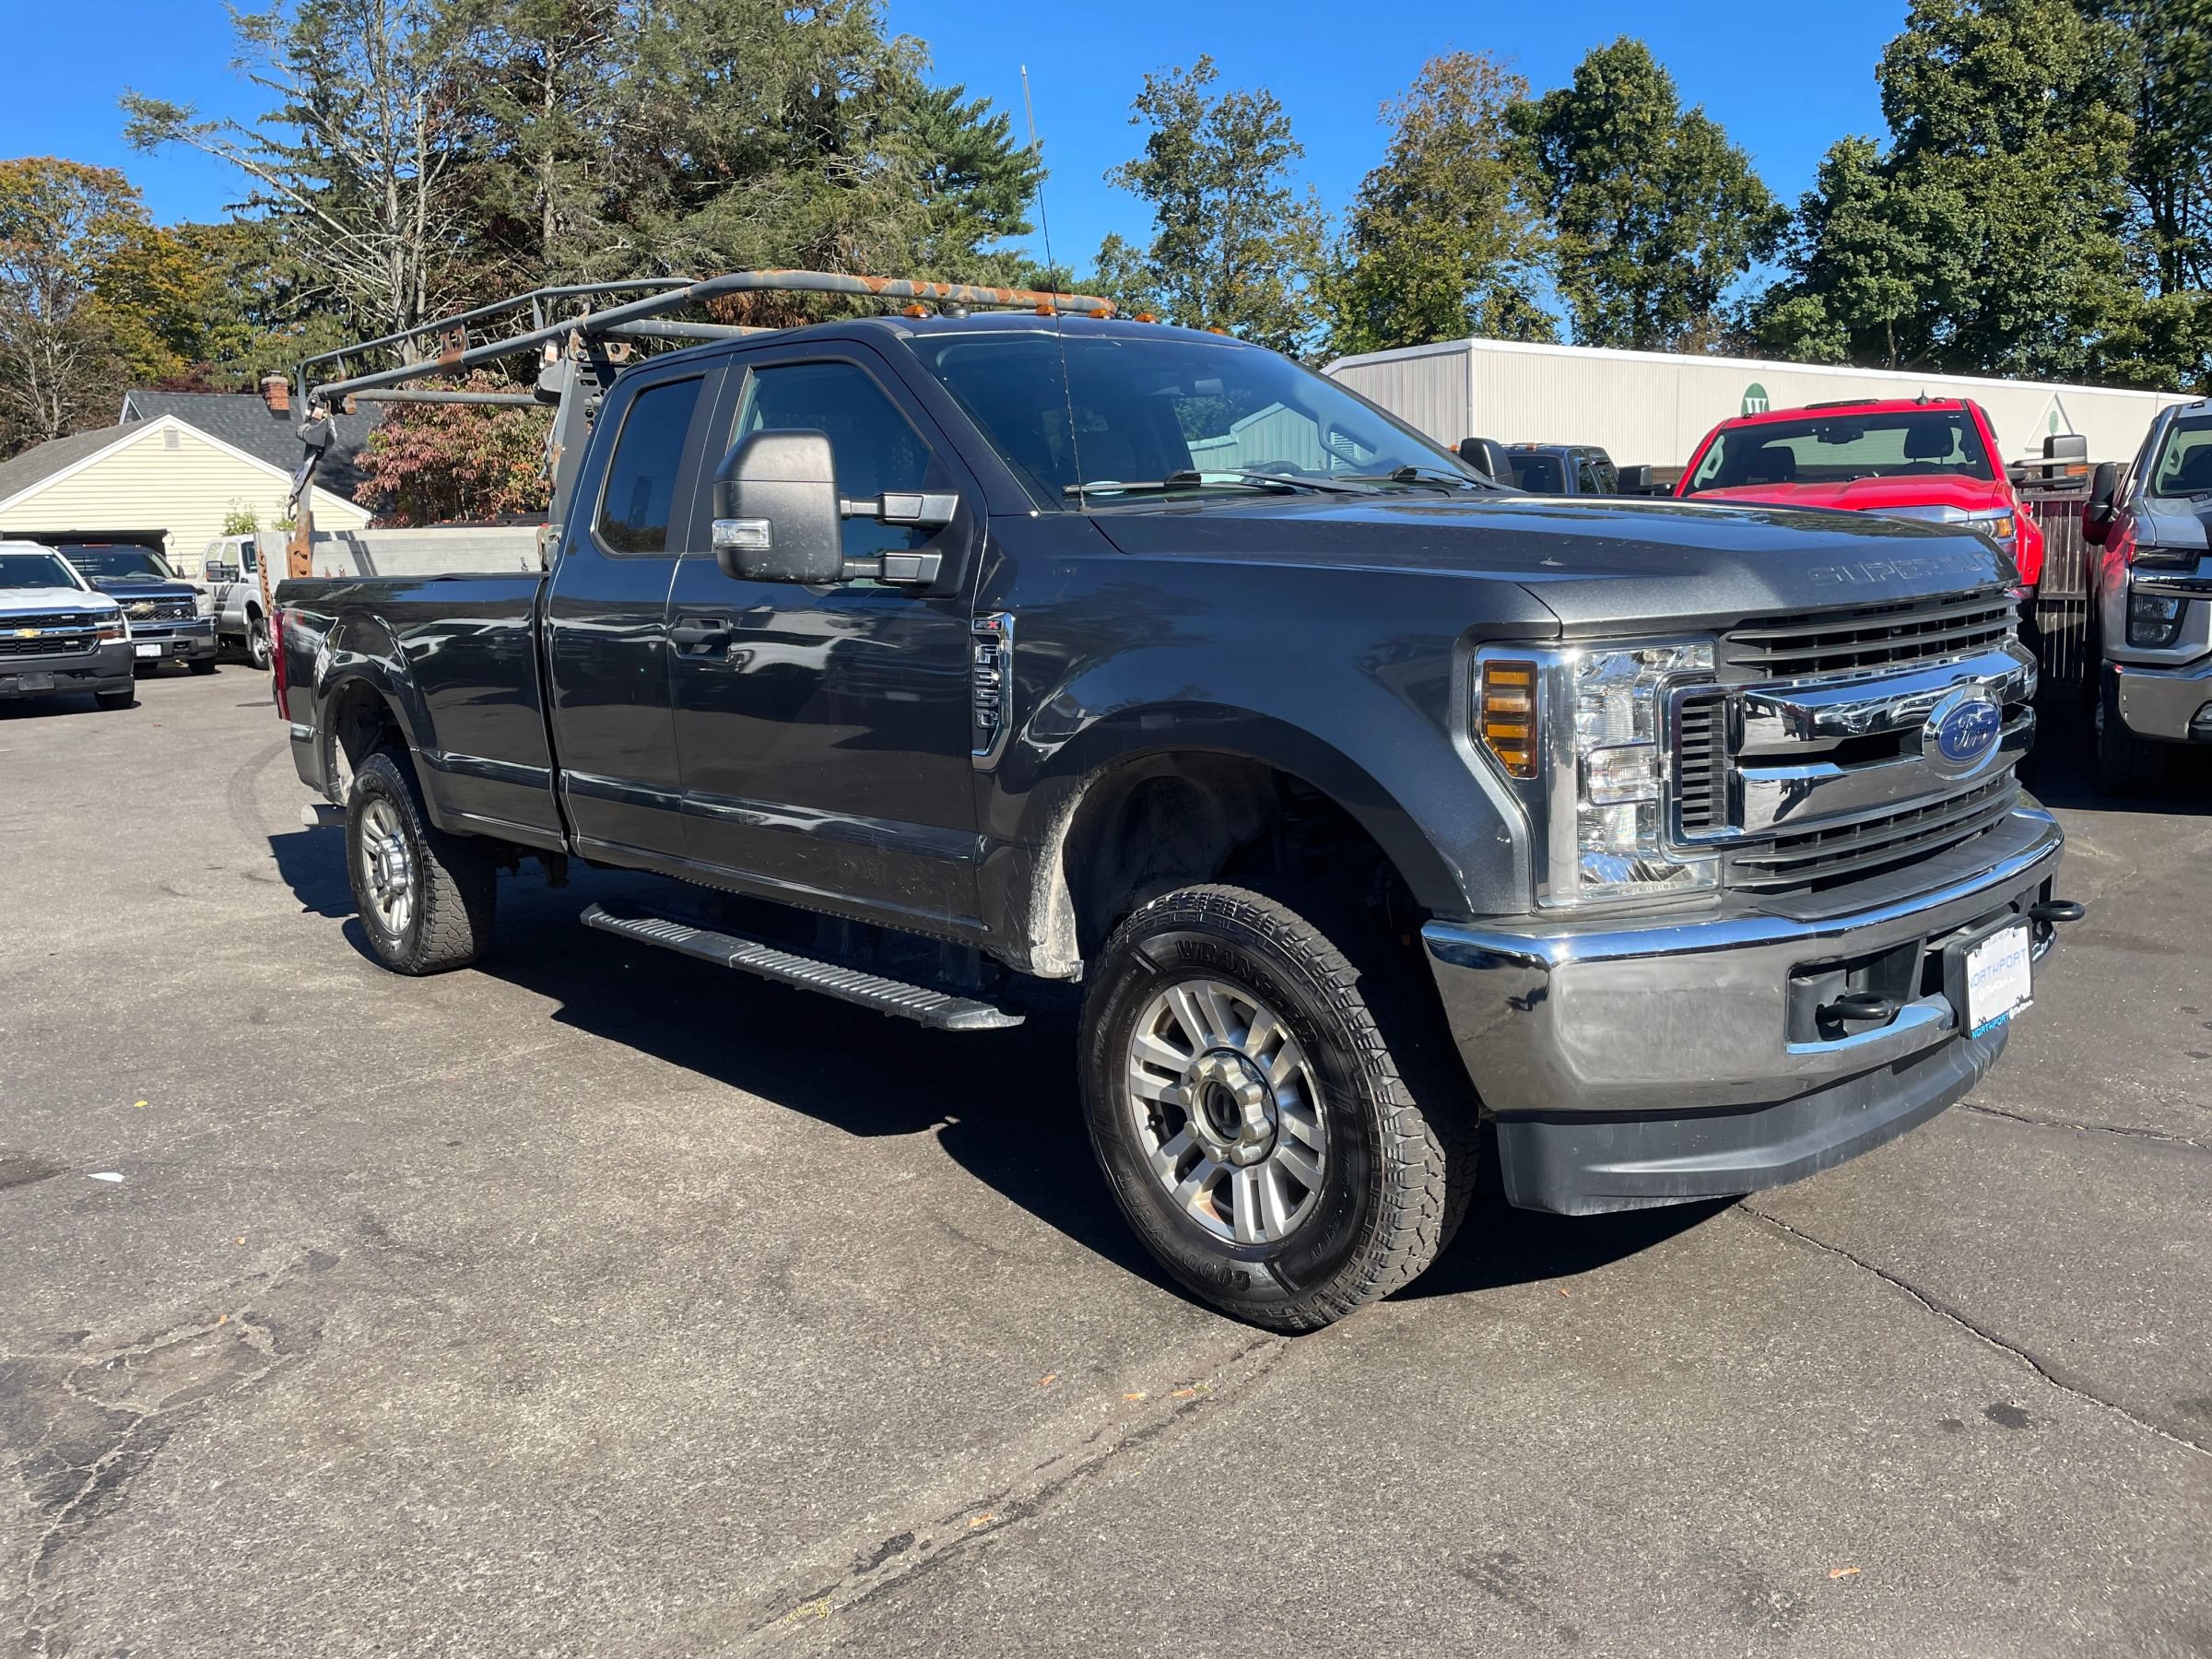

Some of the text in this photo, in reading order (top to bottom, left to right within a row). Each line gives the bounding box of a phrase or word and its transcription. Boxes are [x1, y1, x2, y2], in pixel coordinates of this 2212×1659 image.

[975, 620, 1000, 630] STX
[1953, 712, 1993, 752] Ford
[1970, 948, 2027, 989] NORTHPORT
[1971, 1012, 2009, 1039] NORTHPORT
